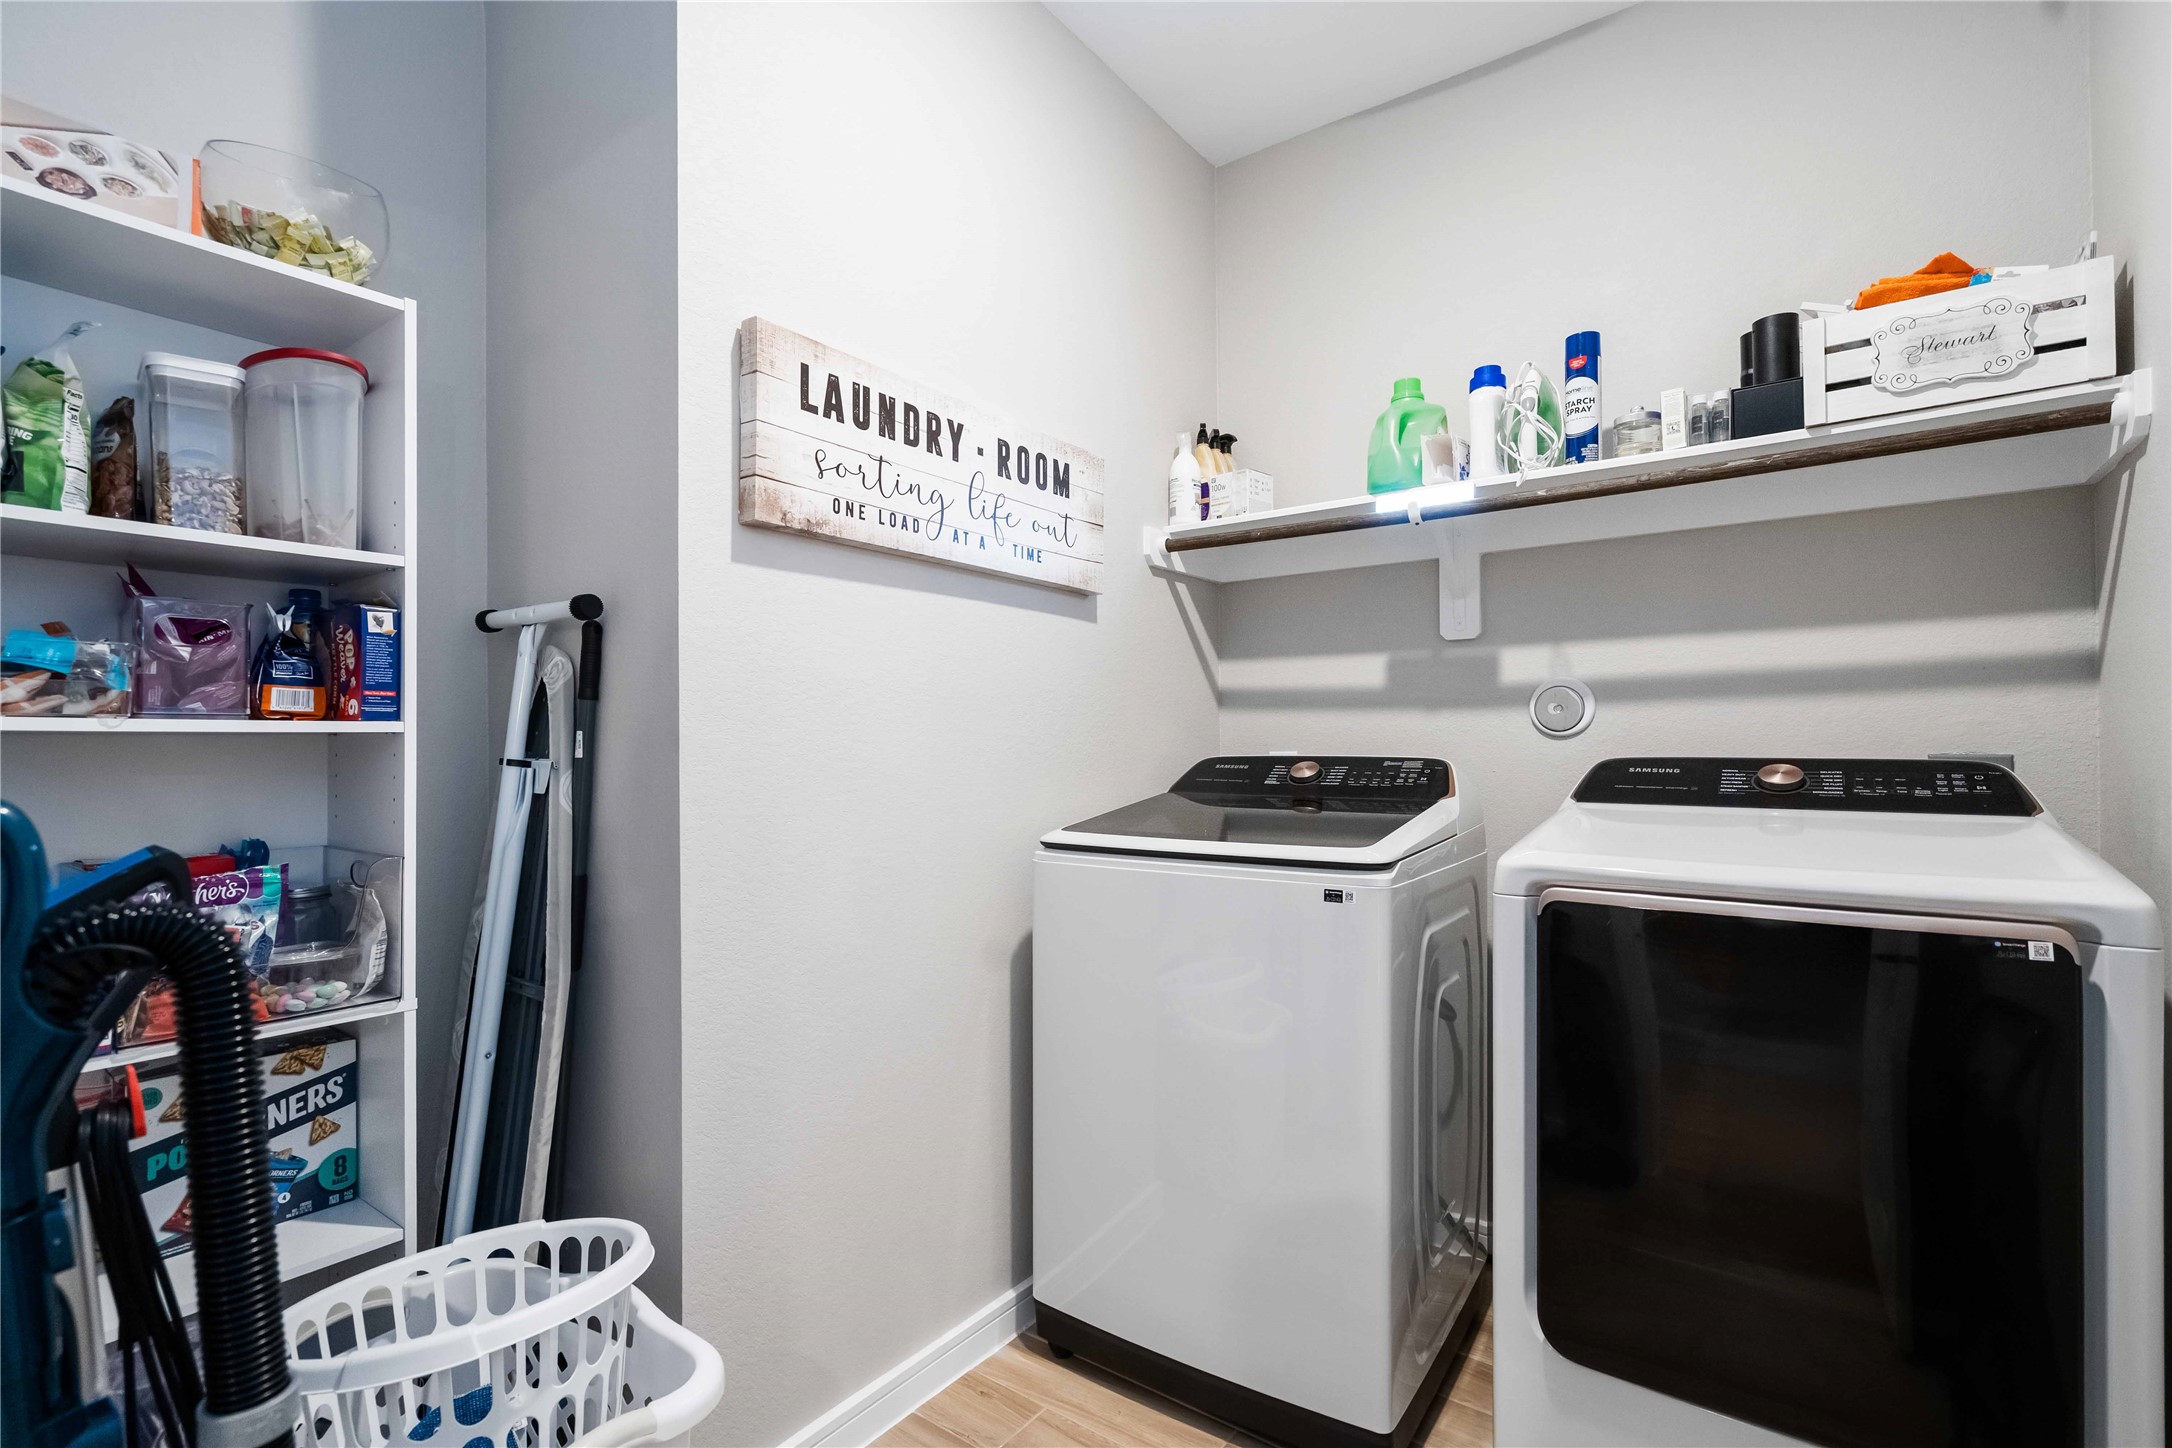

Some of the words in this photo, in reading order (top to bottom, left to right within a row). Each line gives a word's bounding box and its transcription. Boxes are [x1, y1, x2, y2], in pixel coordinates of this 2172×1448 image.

[1901, 325, 1998, 364] Stewart
[1565, 397, 1596, 410] STARCH
[1566, 405, 1593, 417] SPRAY
[800, 362, 964, 462] LAUNDRY
[997, 437, 1070, 499] ROOM
[814, 448, 954, 541] sorting
[968, 471, 1021, 547] life
[1032, 513, 1078, 548] out
[832, 497, 866, 521] ONE
[878, 508, 920, 534] LOAD
[952, 529, 969, 546] AT
[979, 536, 986, 550] A
[1012, 544, 1042, 563] TIME
[335, 625, 348, 683] Weaver
[344, 629, 356, 671] POP
[348, 698, 359, 716] 6
[334, 1155, 347, 1177] 8
